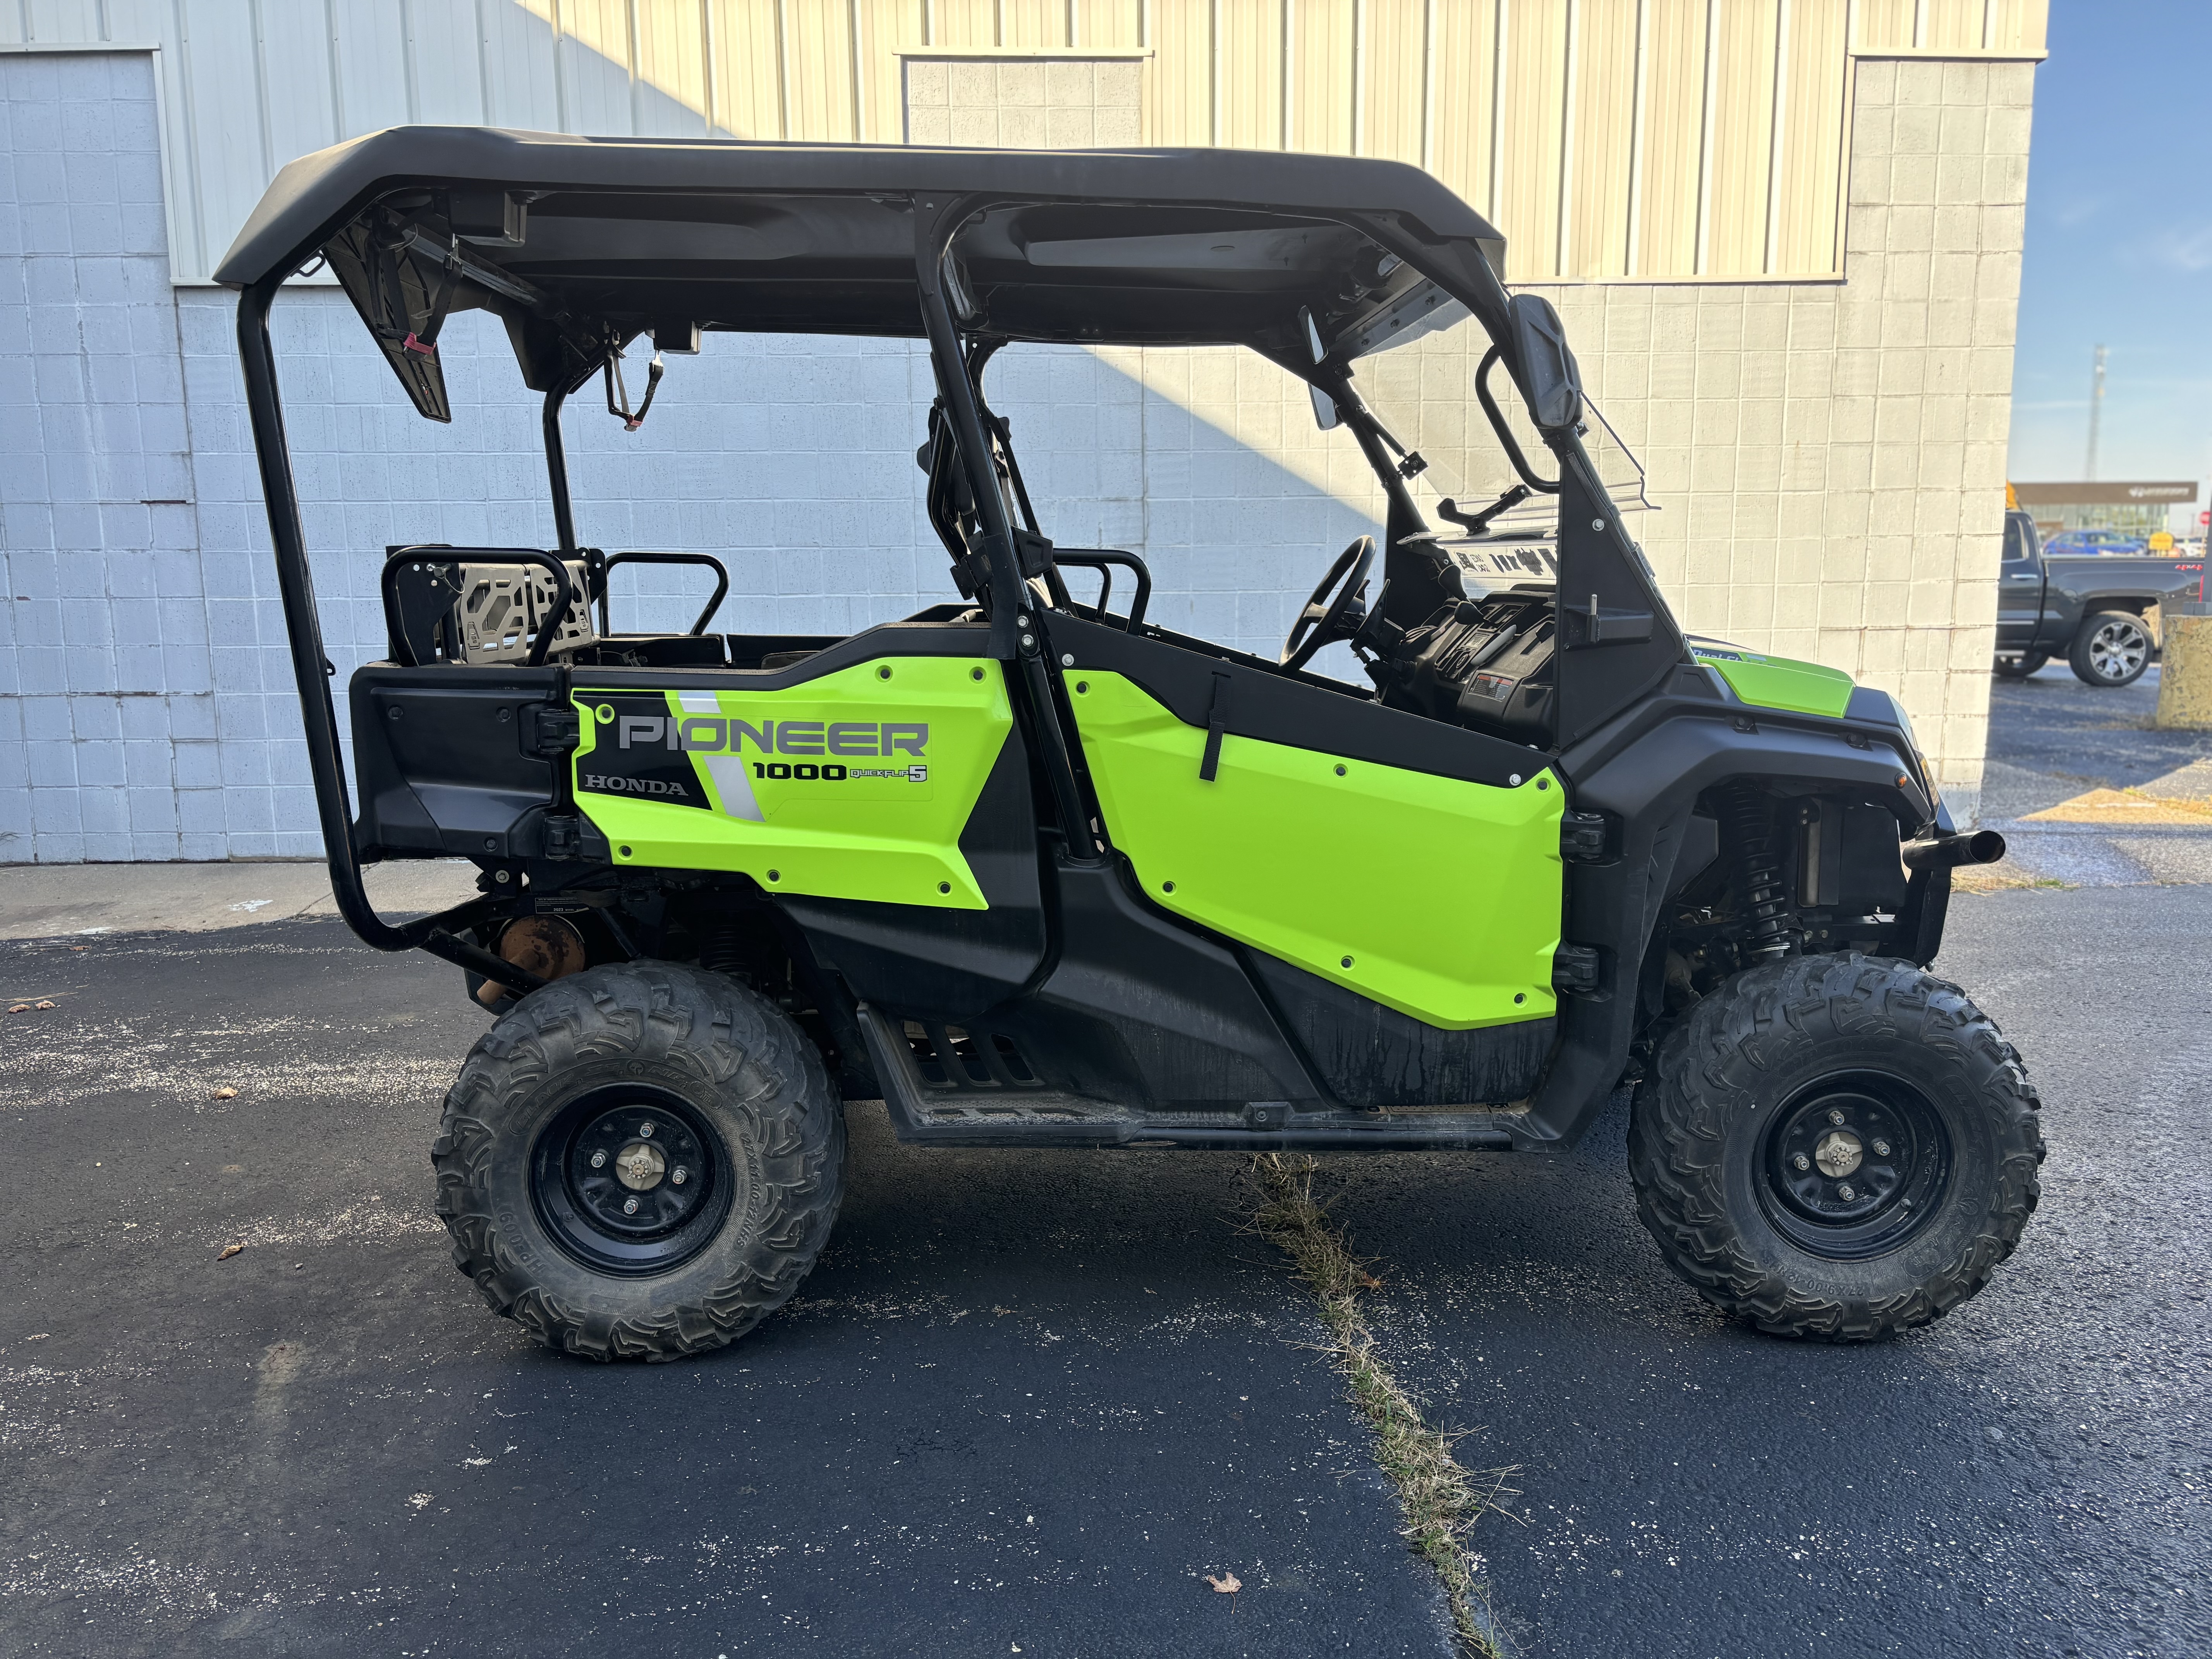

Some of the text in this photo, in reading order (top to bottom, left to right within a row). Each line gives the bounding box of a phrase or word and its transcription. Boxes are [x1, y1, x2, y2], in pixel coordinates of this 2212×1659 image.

[619, 715, 929, 757] PIONEER
[753, 763, 847, 781] 1000
[585, 775, 689, 796] HONDA
